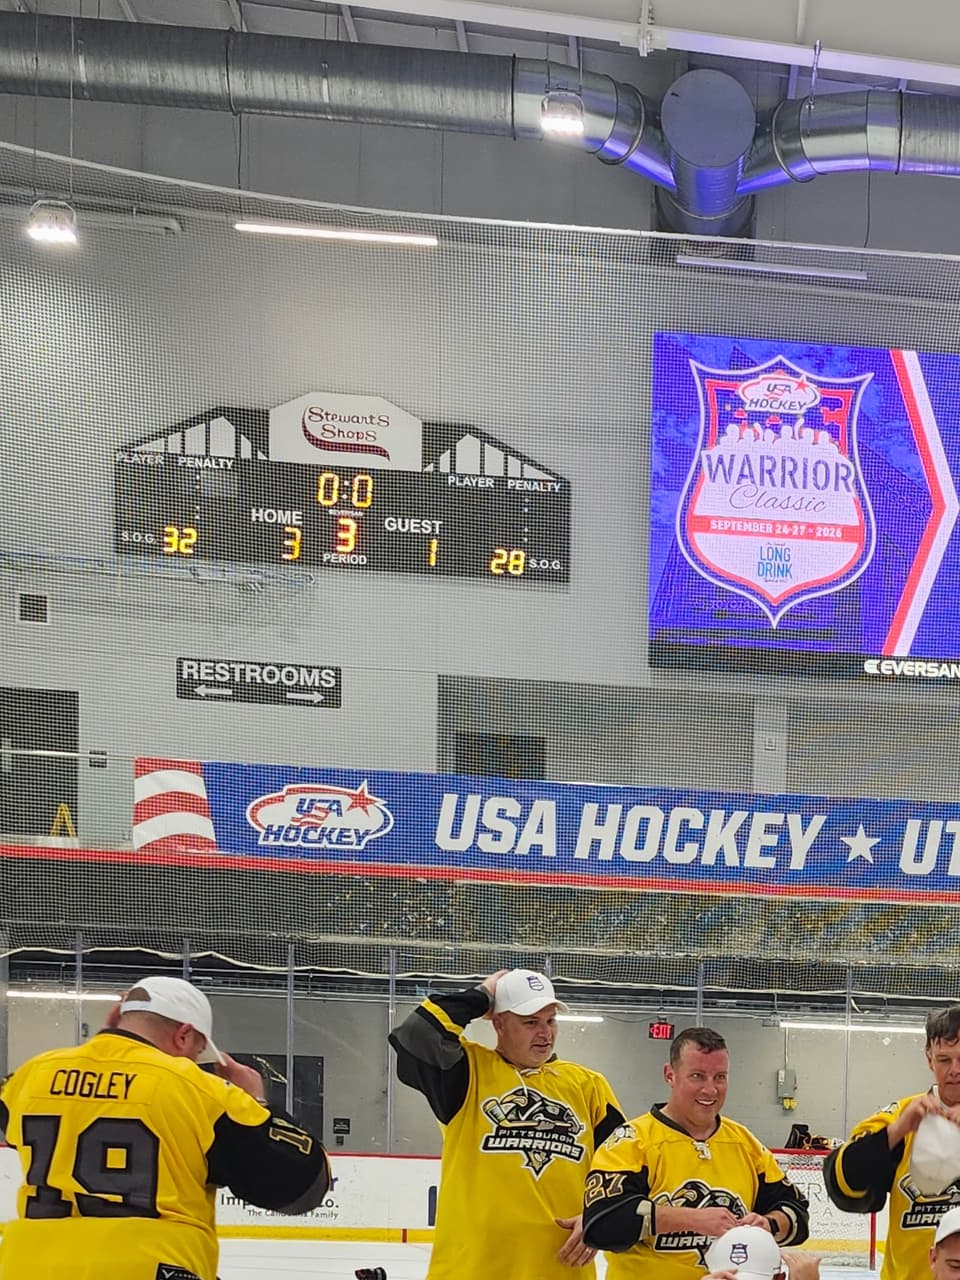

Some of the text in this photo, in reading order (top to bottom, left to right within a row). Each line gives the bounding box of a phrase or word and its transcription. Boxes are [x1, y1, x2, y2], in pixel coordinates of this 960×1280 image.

[749, 398, 806, 411] HOCKEY
[115, 452, 235, 469] PLAYER PENALTY
[705, 454, 854, 493] WARRIOR
[447, 475, 561, 492] PLAYER PENALTY
[729, 484, 827, 513] Classic
[251, 508, 443, 534] HOME GUEST
[335, 517, 358, 550] 3
[710, 519, 773, 534] SEPTEMBER
[815, 527, 843, 539] 2026
[163, 527, 198, 554] 32
[282, 526, 302, 560] 3
[429, 538, 438, 566] 1
[322, 553, 368, 565] PERIOD
[490, 548, 526, 574] 28
[759, 546, 791, 562] LONG
[757, 561, 793, 579] DRINK
[182, 660, 336, 688] RESTROOMS
[296, 797, 344, 822] USA
[262, 822, 373, 848] HOCKEY
[435, 793, 557, 858] USA
[574, 802, 826, 871] HOCKEY
[50, 1069, 138, 1100] COGLEY
[487, 1137, 582, 1158] WARRIORS
[499, 1129, 574, 1144] PITTSBURGH
[22, 1114, 162, 1219] 19
[585, 1172, 628, 1209] 27
